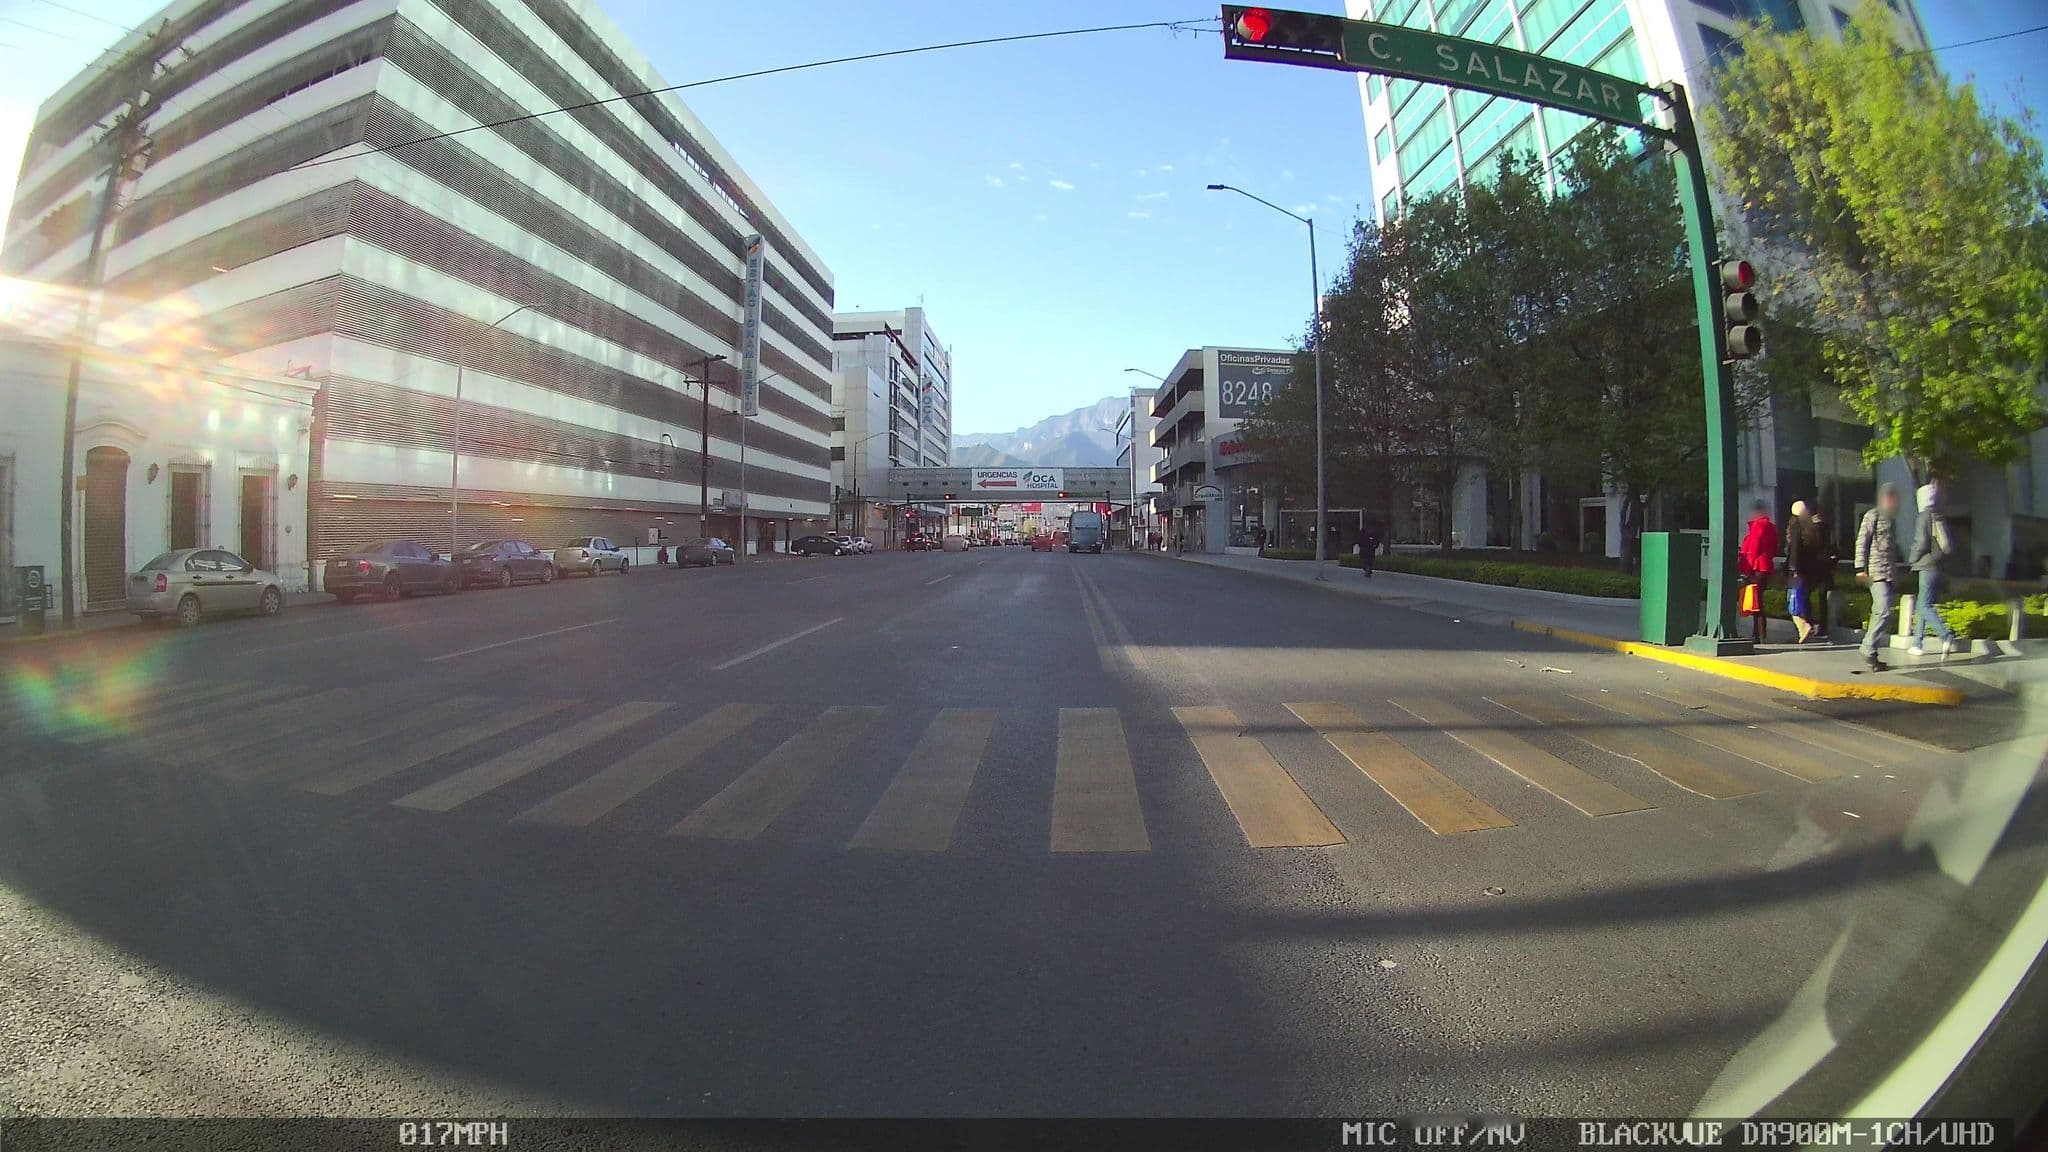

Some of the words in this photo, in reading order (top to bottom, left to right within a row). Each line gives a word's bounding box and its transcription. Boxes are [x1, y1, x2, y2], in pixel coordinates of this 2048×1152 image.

[1367, 32, 1402, 62] C.
[1435, 44, 1622, 111] SALAZAR
[1222, 380, 1272, 405] 8248
[922, 396, 932, 424] OCA
